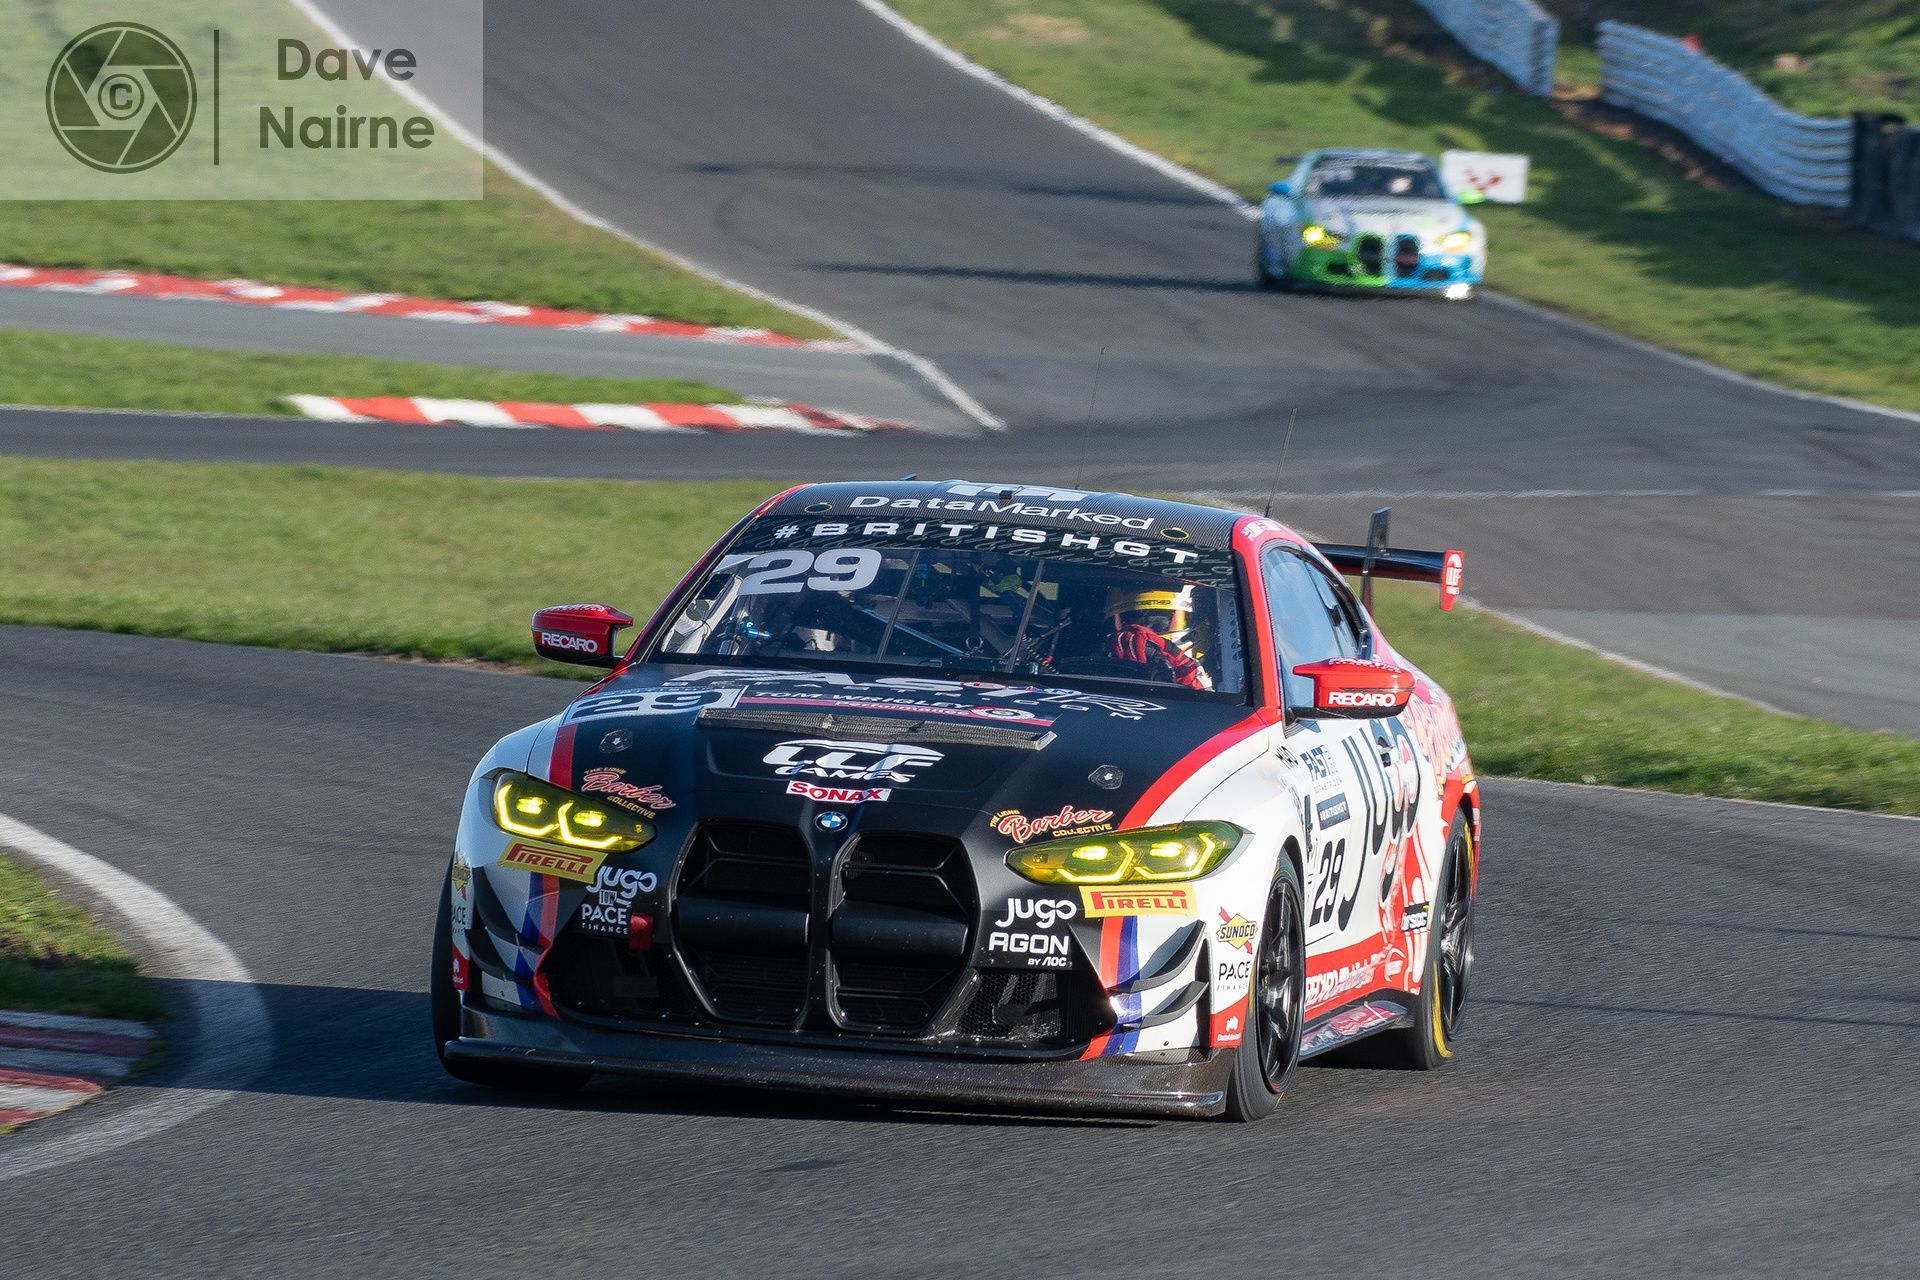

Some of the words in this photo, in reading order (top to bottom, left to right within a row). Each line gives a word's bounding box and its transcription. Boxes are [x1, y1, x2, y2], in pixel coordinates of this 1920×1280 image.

[850, 496, 1154, 530] DataMarked
[737, 547, 883, 596] 29
[541, 631, 599, 654] RECARO
[571, 690, 724, 720] 29
[755, 690, 823, 699] TOM
[832, 693, 973, 709] WRIGLEY
[1328, 692, 1397, 708] RECARO
[774, 765, 916, 784] GAMES
[581, 771, 677, 809] Barber
[790, 783, 884, 801] SONAX
[607, 795, 656, 819] COLLECTIVE
[998, 804, 1114, 844] Barber
[1052, 823, 1113, 837] COLLECTIVE
[505, 842, 594, 875] PIRELLI
[1309, 838, 1346, 928] 29
[600, 890, 617, 905] TOW
[1090, 889, 1188, 910] PIRELLI
[581, 903, 629, 926] PACE
[994, 898, 1077, 929] jugo
[581, 921, 629, 935] FINANCE
[1219, 924, 1257, 940] SUNOCO
[989, 931, 1070, 955] AGON
[1027, 958, 1041, 966] BY
[1218, 960, 1251, 982] PACE
